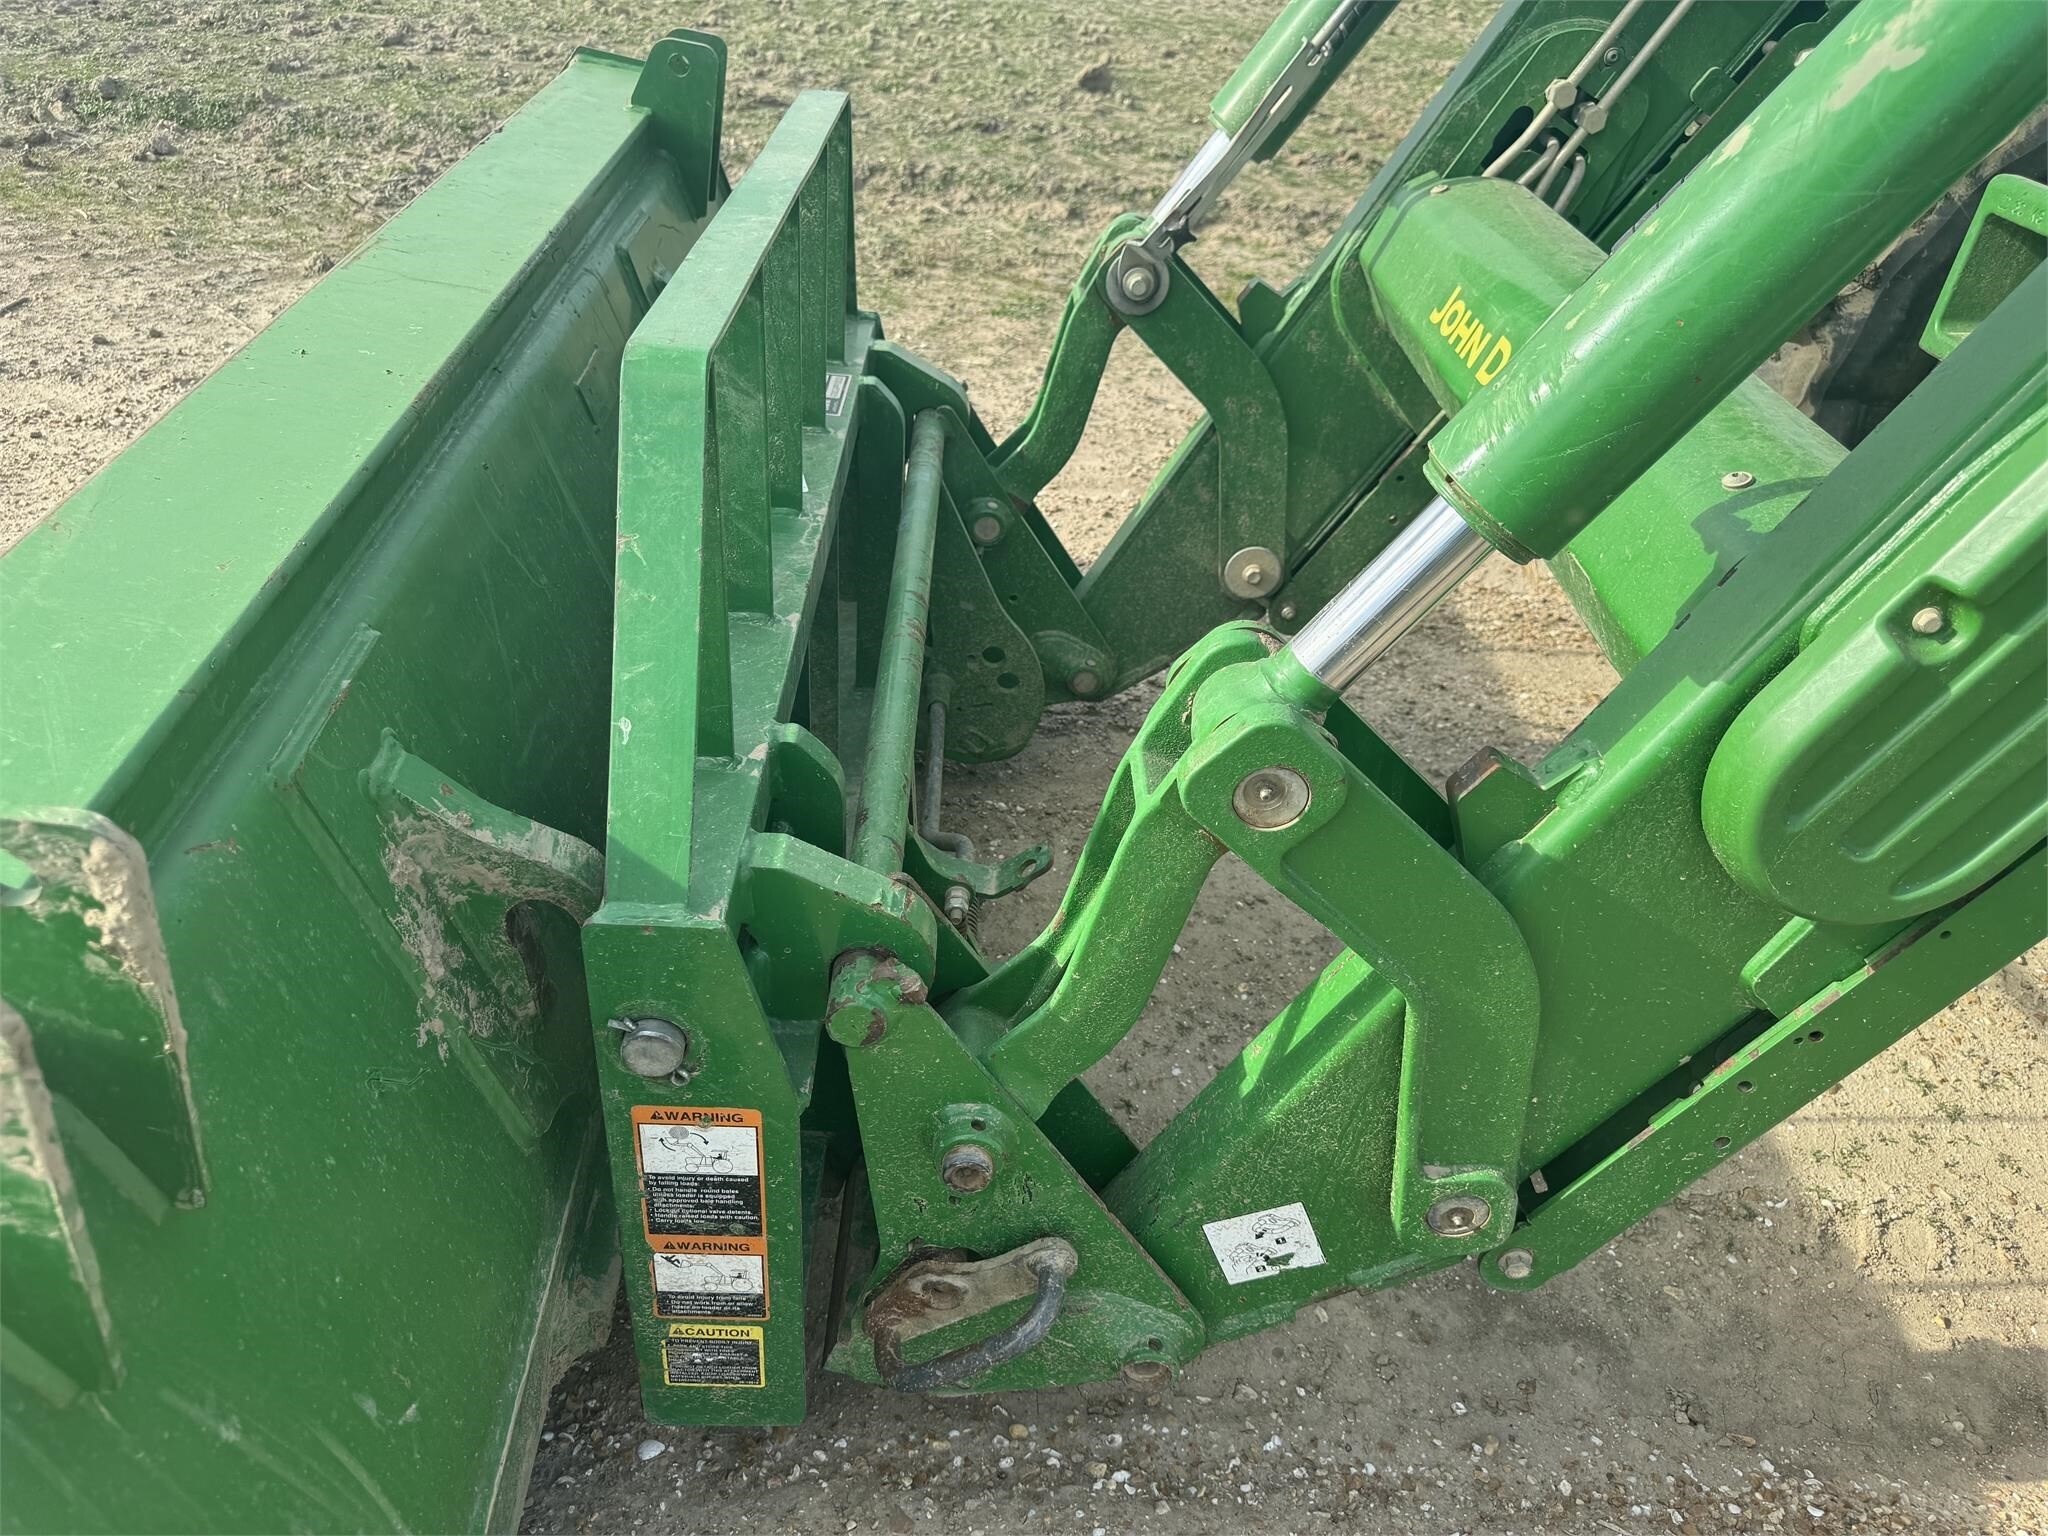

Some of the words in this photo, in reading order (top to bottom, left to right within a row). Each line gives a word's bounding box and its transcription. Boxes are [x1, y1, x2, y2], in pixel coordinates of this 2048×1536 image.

[1429, 284, 1493, 369] JOHN
[664, 1110, 744, 1123] WARNING
[678, 1242, 750, 1252] WARNING
[685, 1328, 750, 1337] CAUTION
